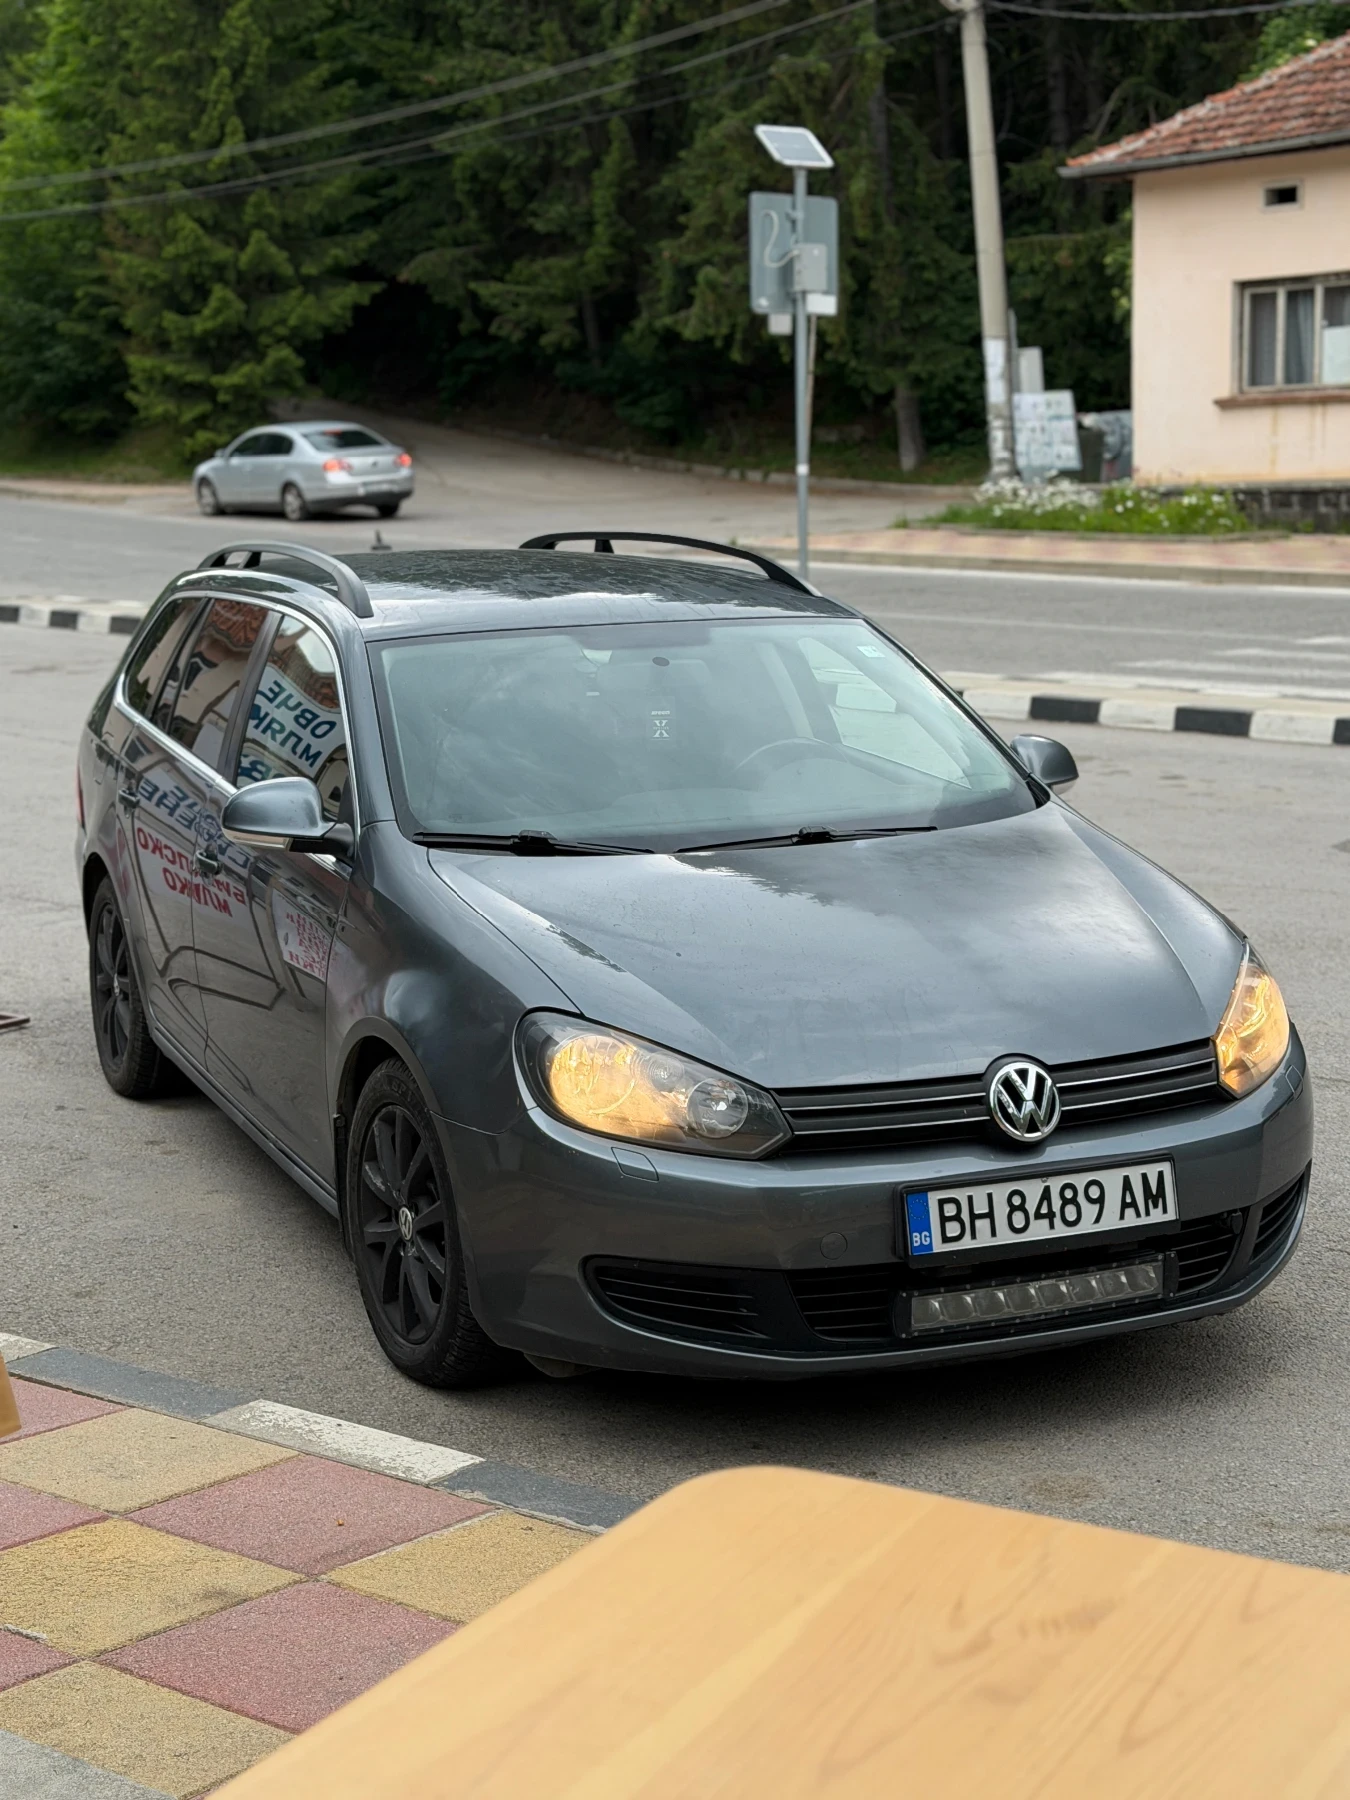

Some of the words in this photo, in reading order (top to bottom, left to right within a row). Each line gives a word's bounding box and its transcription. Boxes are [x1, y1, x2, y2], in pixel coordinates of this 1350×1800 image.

[937, 1192, 997, 1244] BH
[1006, 1178, 1107, 1235] 8489
[1119, 1169, 1168, 1221] AM
[912, 1231, 931, 1247] BG
